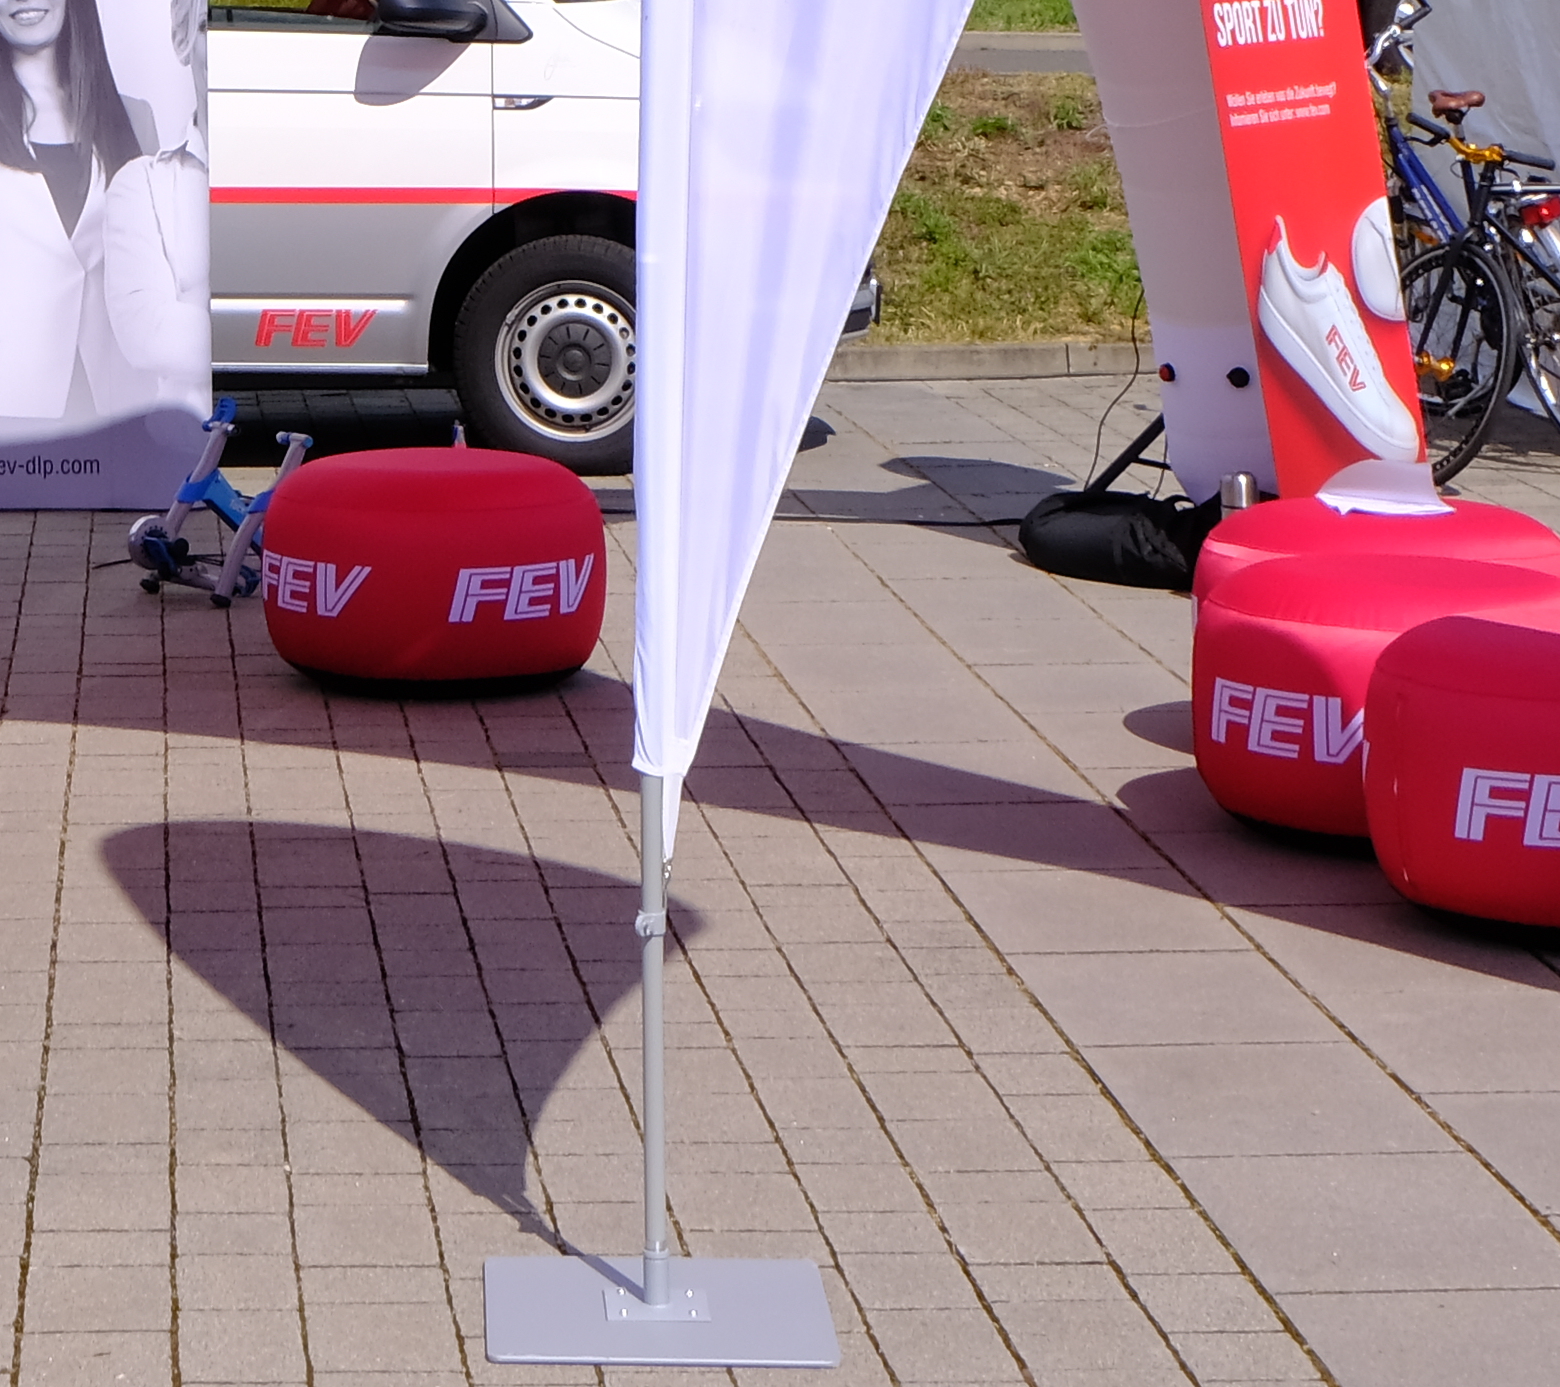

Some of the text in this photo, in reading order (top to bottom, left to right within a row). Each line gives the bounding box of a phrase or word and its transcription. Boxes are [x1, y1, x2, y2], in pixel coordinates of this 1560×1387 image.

[1213, 0, 1263, 47] SPORT
[255, 309, 378, 347] FEV
[1326, 324, 1366, 392] FEV
[262, 549, 594, 623] FEV FEV
[1211, 677, 1364, 764] FEV
